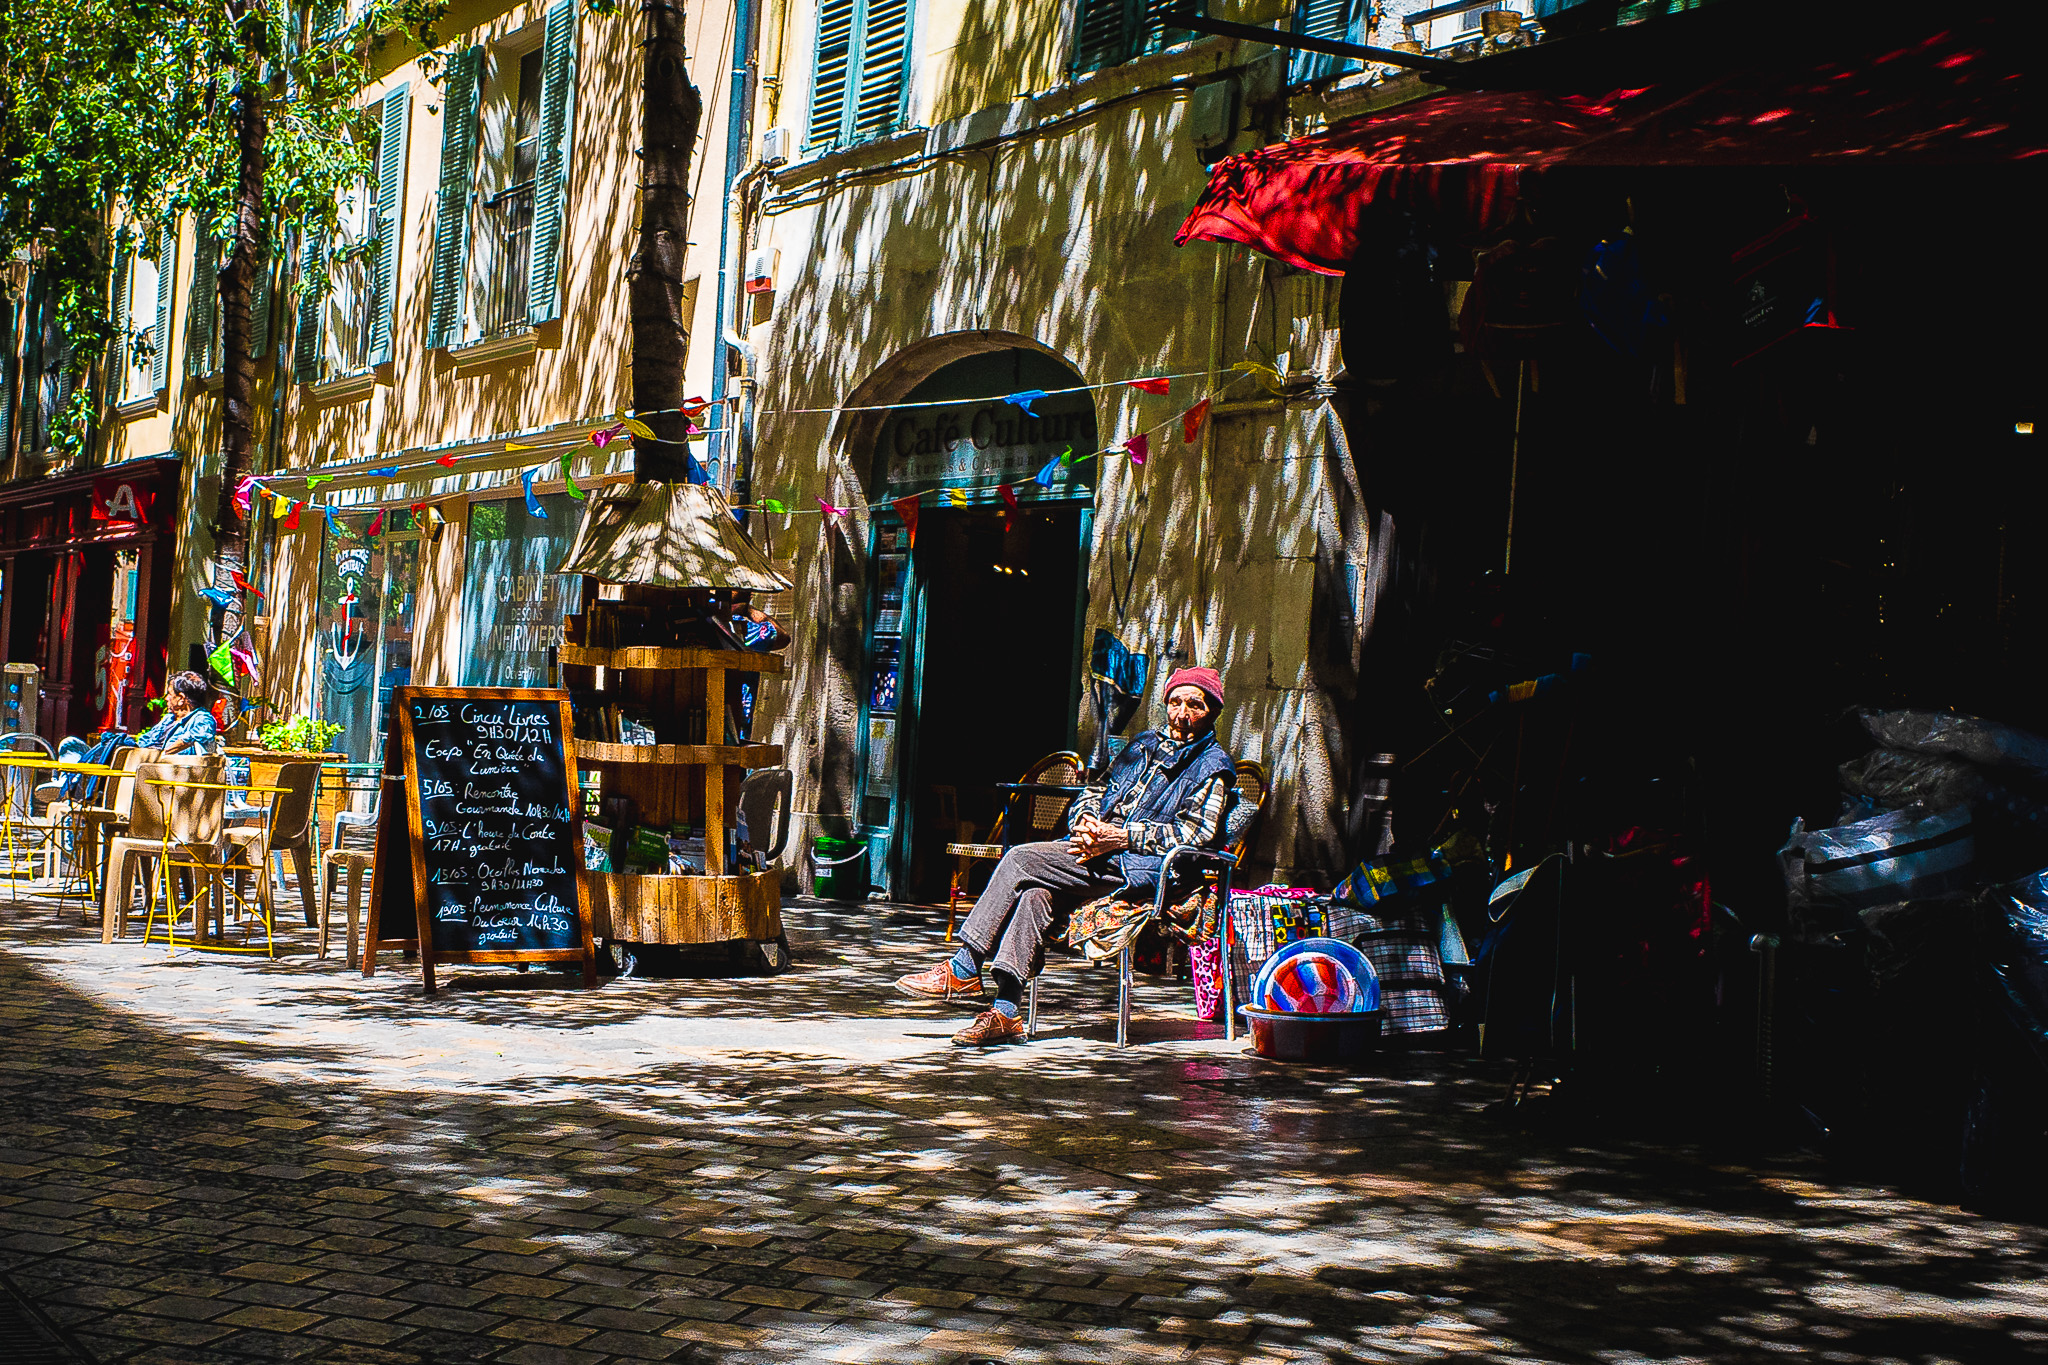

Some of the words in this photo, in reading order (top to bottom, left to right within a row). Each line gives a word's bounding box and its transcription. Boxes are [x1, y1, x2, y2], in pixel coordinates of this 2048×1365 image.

[893, 412, 961, 457] Café
[971, 407, 1097, 451] Culture
[105, 484, 138, 519] A
[338, 559, 365, 577] CENTRALE
[498, 575, 558, 602] CABINET
[511, 607, 521, 621] DE
[488, 625, 565, 652] INFIRMIERS
[425, 739, 463, 762] Expo
[528, 747, 545, 761] de
[464, 782, 520, 800] Rencontre
[455, 799, 524, 816] Gourmande
[462, 820, 505, 839] L'heure
[508, 822, 520, 839] du
[522, 823, 557, 840] Conte
[469, 839, 513, 858] gratuit
[534, 892, 575, 916] Culture
[472, 915, 490, 928] Du
[478, 928, 519, 946] gratuit
